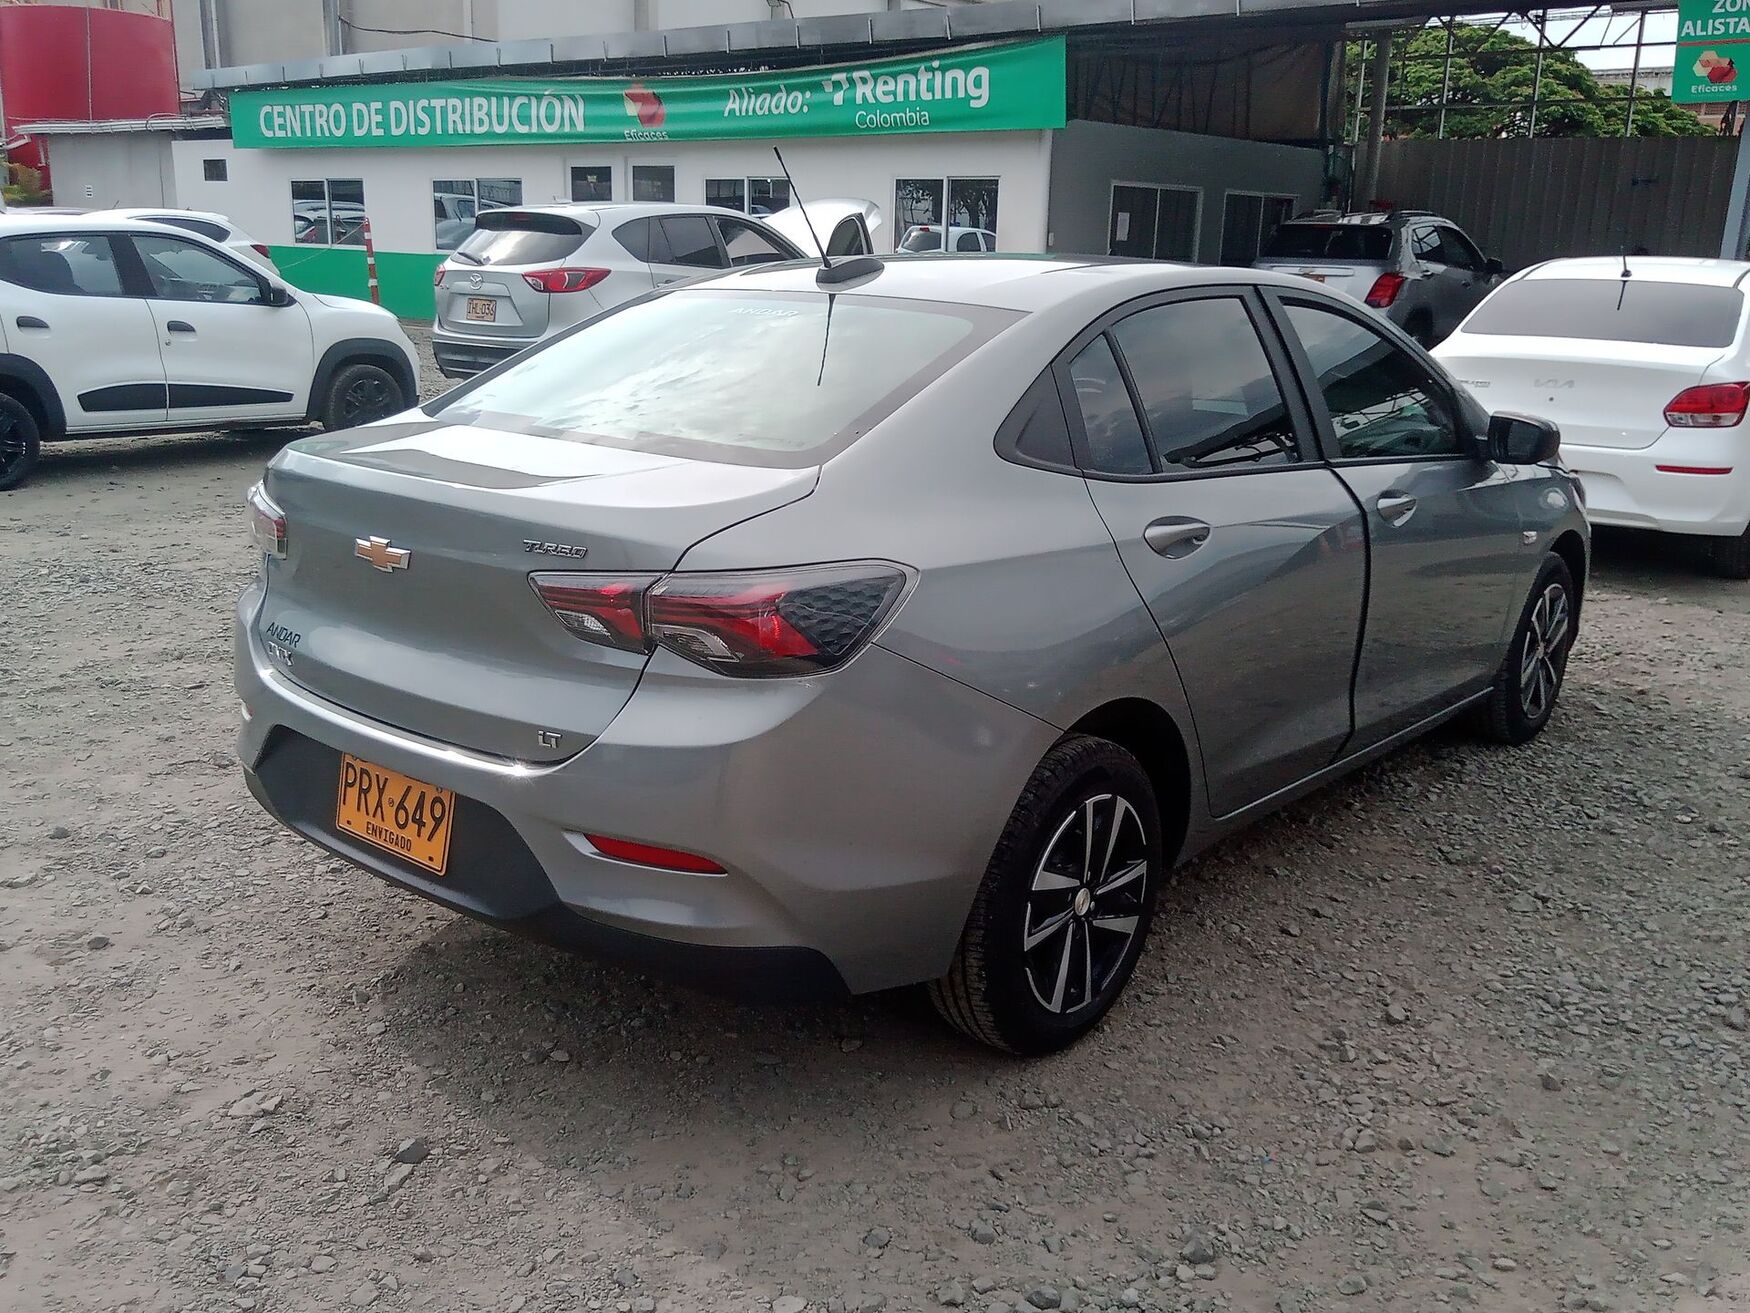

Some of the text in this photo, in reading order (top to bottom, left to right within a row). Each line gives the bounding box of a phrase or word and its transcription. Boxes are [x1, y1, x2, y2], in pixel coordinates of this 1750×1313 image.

[852, 60, 990, 109] Renting
[1691, 84, 1737, 94] Eficaces
[258, 89, 585, 138] CENTRO DE DISTRIBUCIÓN
[723, 84, 812, 118] Aliado:
[855, 108, 930, 129] Colombia
[522, 539, 588, 559] TURBO
[265, 621, 302, 649] ANDAR
[537, 730, 563, 749] LT
[342, 761, 446, 841] PRX 649
[365, 821, 413, 853] ENVIGADO
